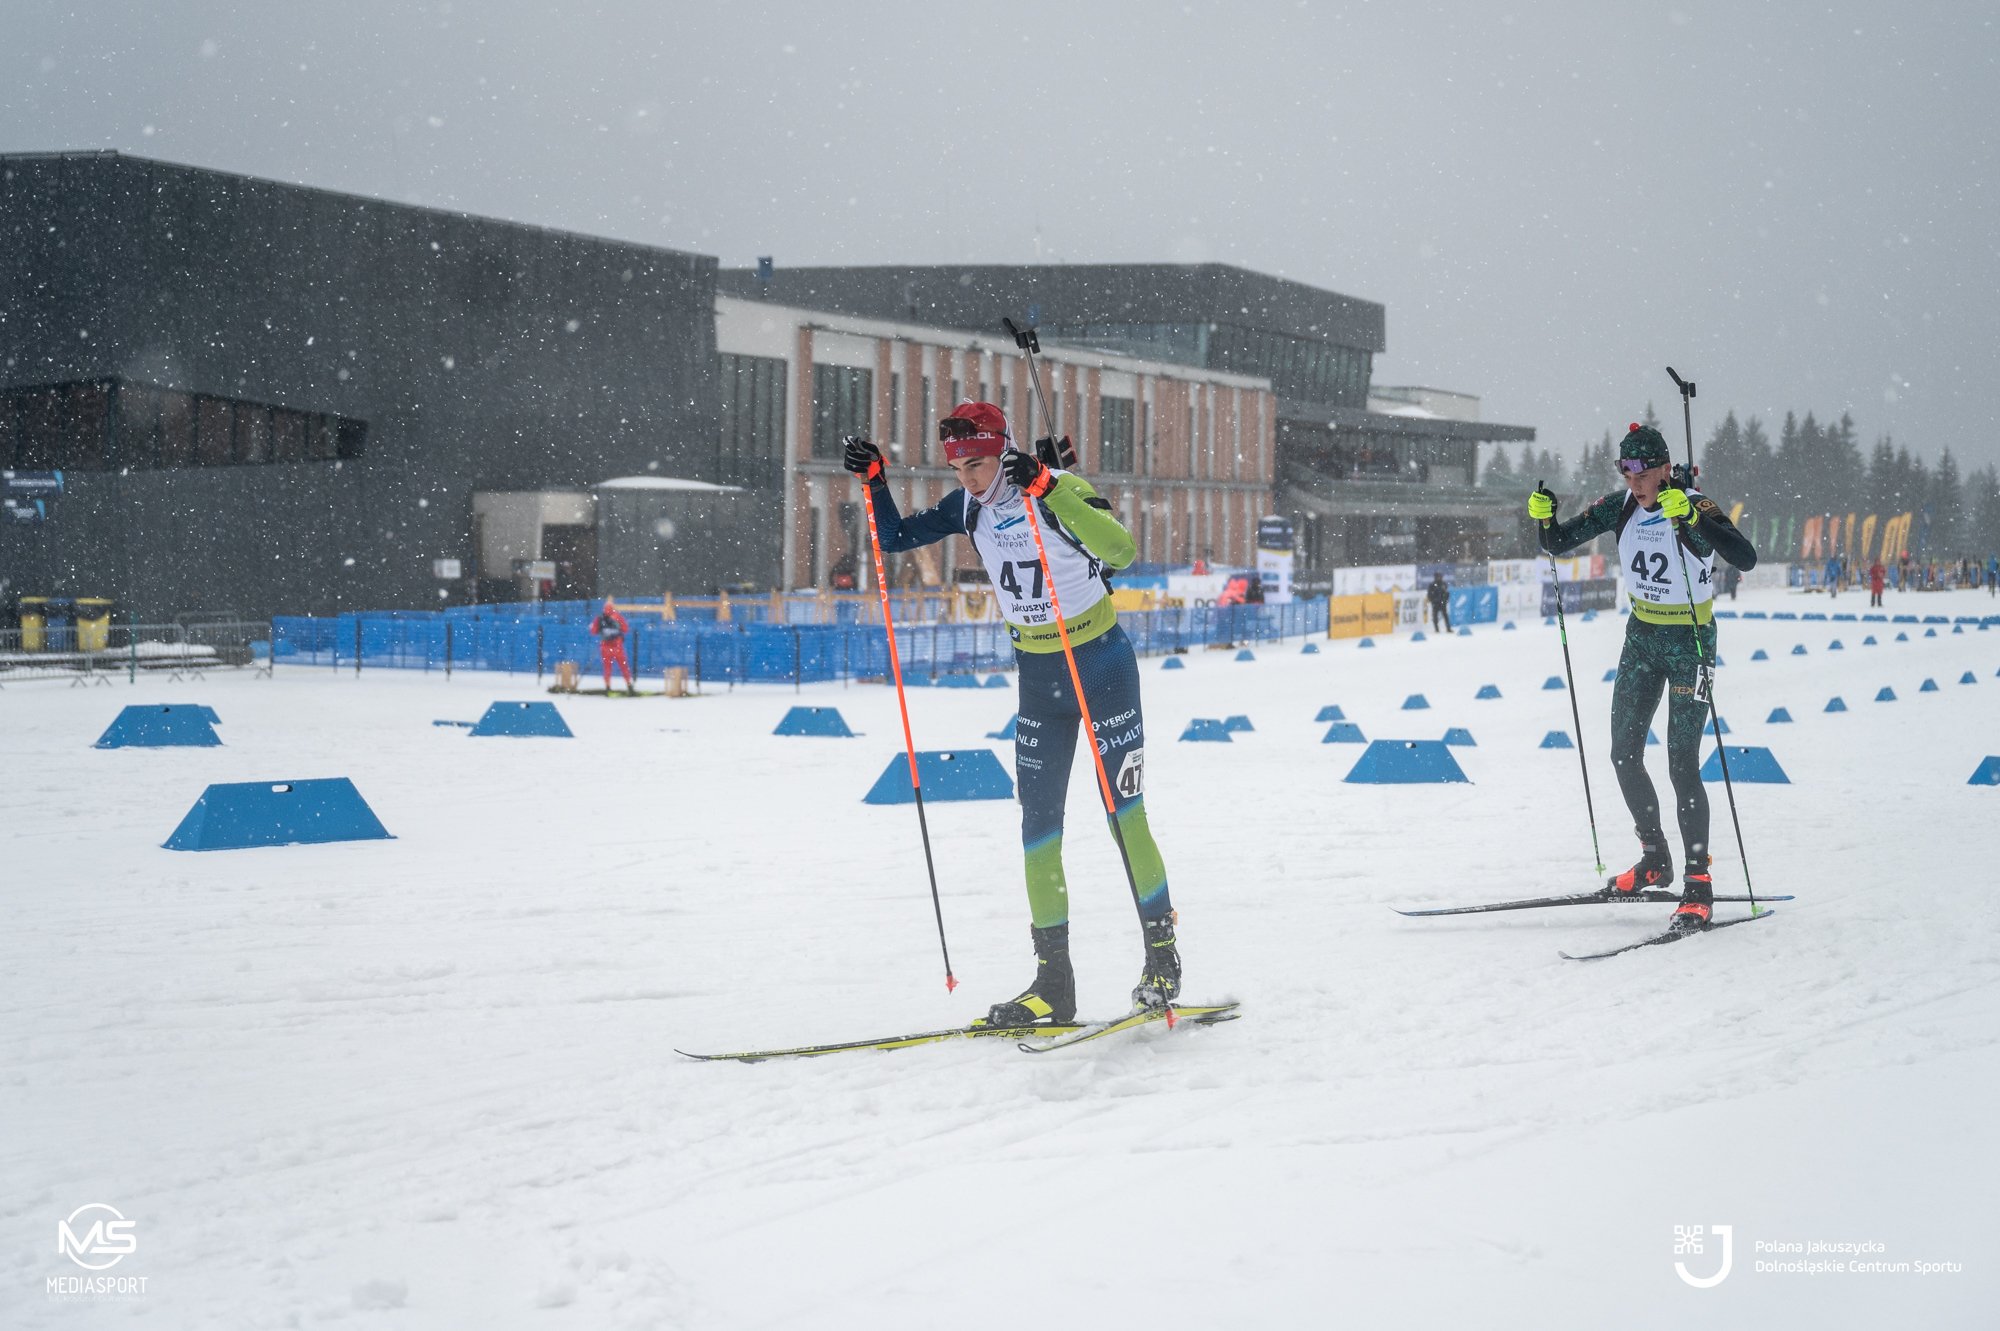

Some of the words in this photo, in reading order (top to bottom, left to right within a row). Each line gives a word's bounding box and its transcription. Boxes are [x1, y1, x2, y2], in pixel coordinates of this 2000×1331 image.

[944, 432, 996, 445] PEOL
[1631, 550, 1672, 585] 42
[1000, 559, 1044, 599] 47
[1636, 581, 1670, 595] Jakuszyce
[1011, 602, 1053, 613] Jakuszyc
[1645, 608, 1667, 616] OFFICIAL
[1031, 631, 1061, 640] OFFICIAL
[1065, 626, 1075, 635] BU
[1077, 619, 1092, 631] APP
[1017, 715, 1042, 728] umar
[1101, 708, 1137, 727] VERIGA
[1017, 733, 1038, 747] NLB
[1110, 722, 1142, 748] HALTI
[1018, 754, 1043, 765] Telekom
[1120, 764, 1142, 795] 47
[973, 1029, 1036, 1038] FISCHER
